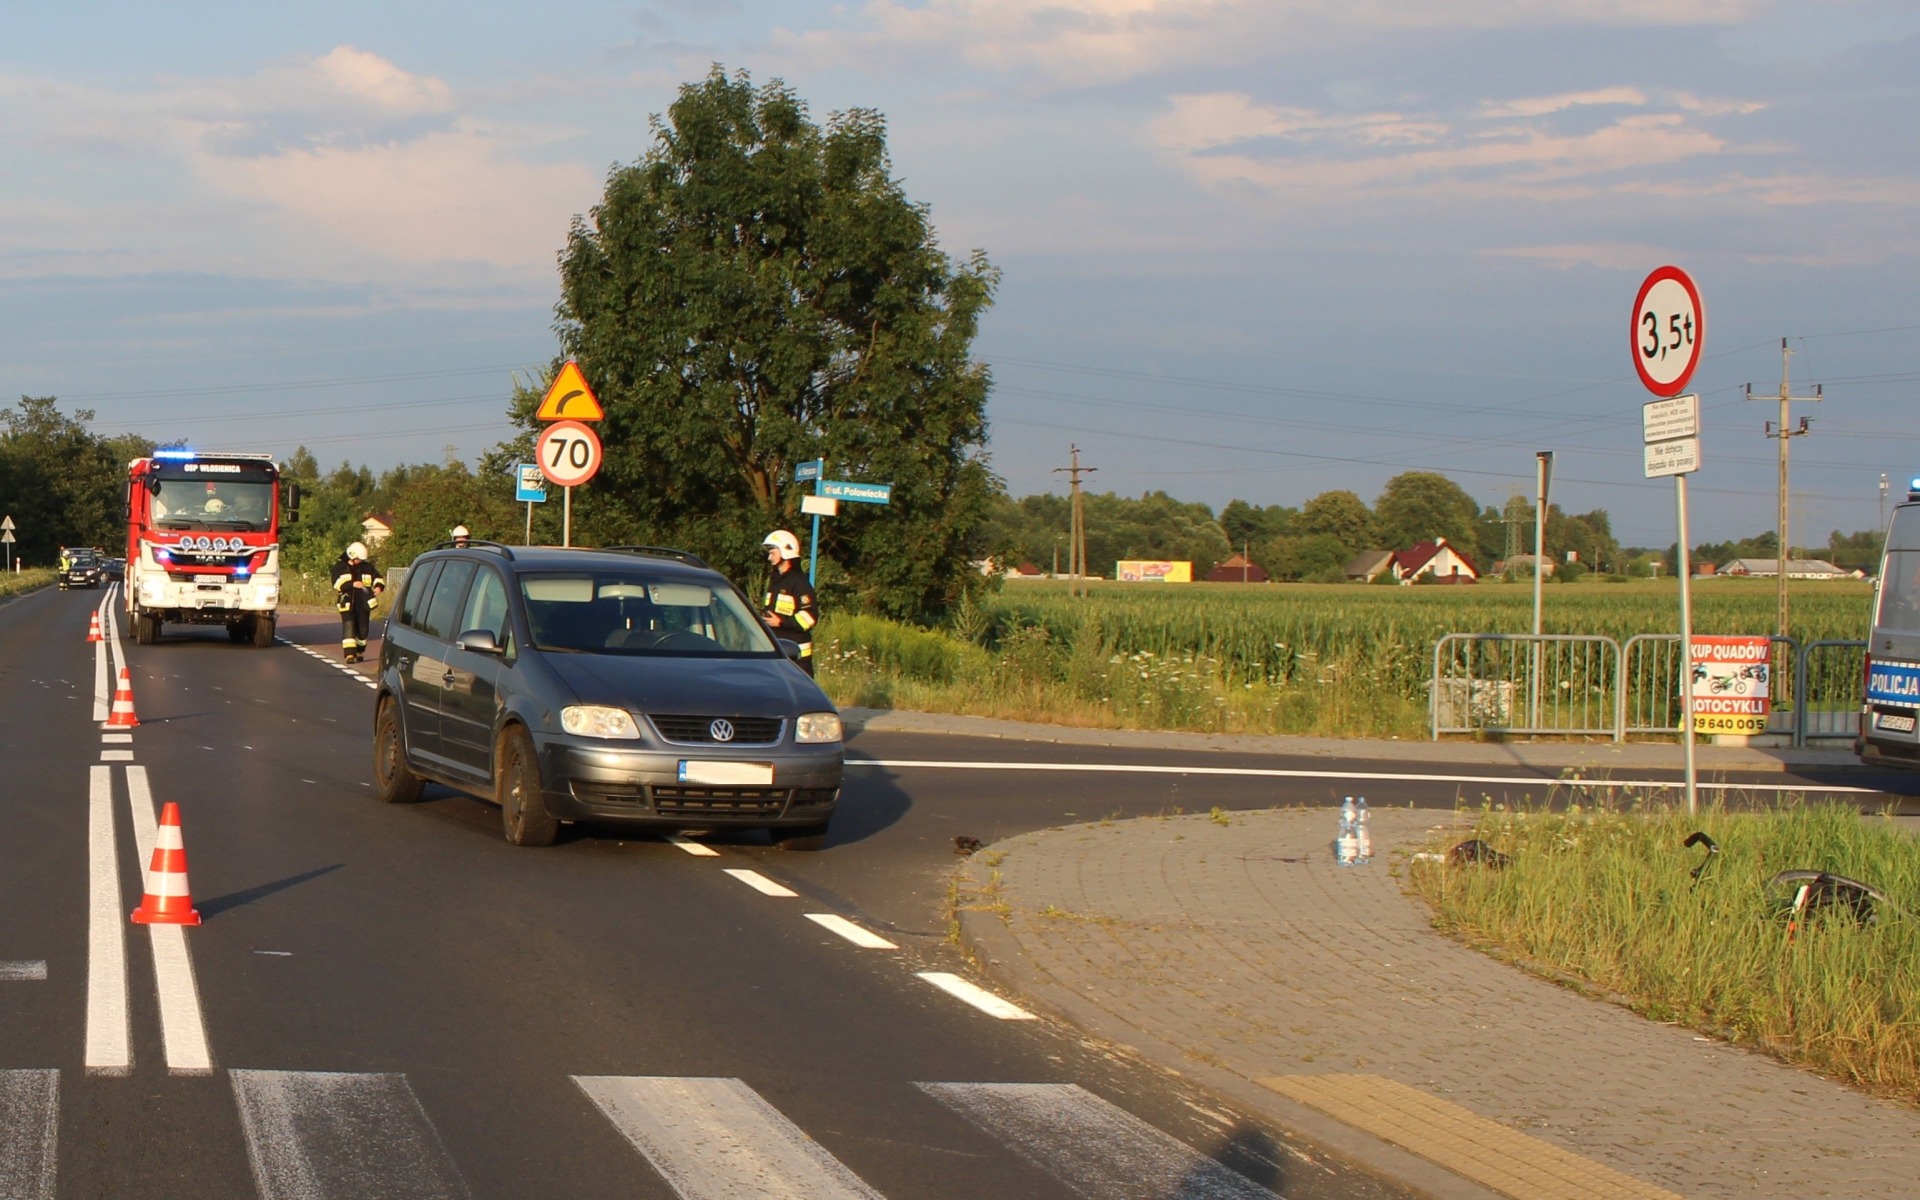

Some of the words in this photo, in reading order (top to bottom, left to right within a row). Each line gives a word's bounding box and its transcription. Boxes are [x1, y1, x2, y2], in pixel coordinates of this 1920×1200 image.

[1642, 311, 1693, 361] 3,5t
[550, 438, 589, 469] 70
[184, 464, 199, 472] OSP
[832, 487, 842, 495] ul.
[1713, 641, 1768, 660] QUADÓW
[1870, 673, 1919, 696] POLICJA
[1692, 699, 1763, 713] OTOCYKLI
[1708, 719, 1734, 729] 640
[1736, 719, 1765, 729] 005
